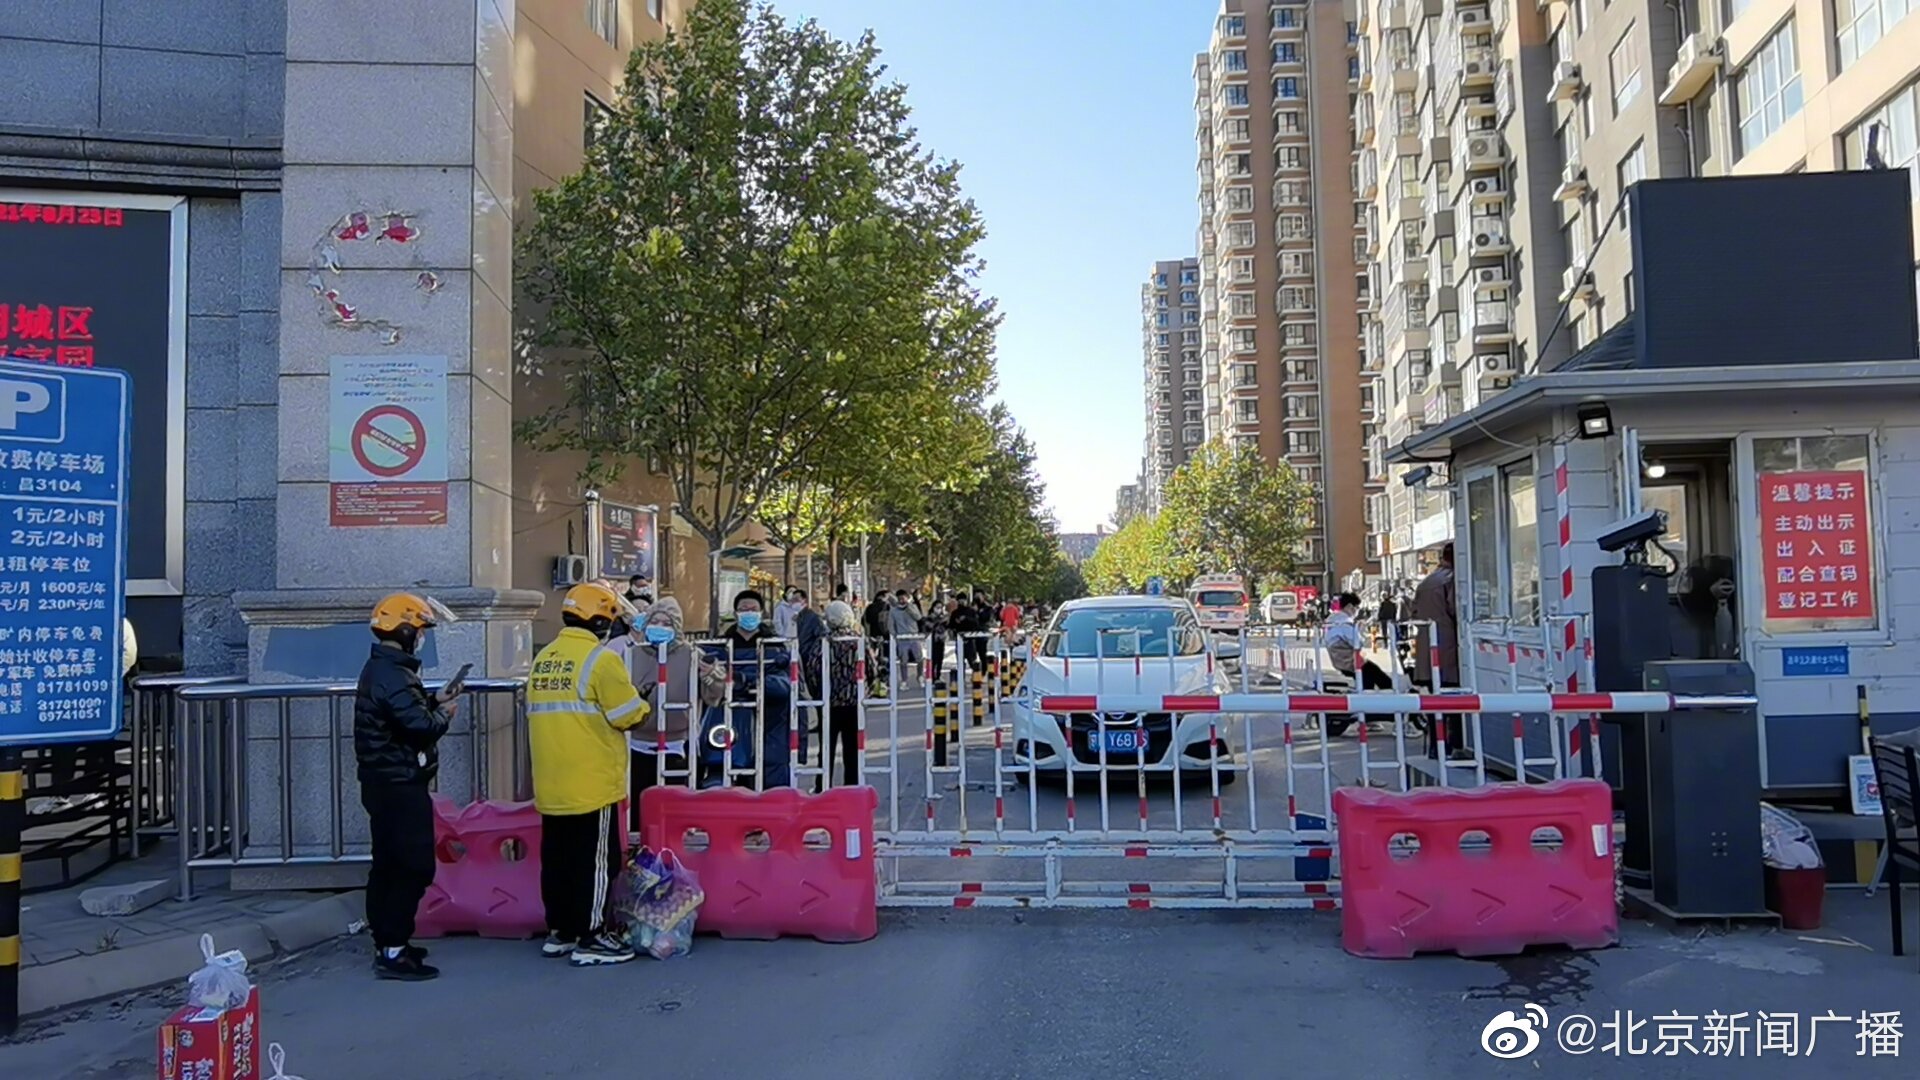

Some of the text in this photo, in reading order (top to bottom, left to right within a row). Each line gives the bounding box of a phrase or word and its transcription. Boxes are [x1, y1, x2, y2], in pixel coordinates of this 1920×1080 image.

[0, 303, 94, 340] 城区
[0, 379, 50, 430] P
[1772, 483, 1855, 502] 温馨提示
[12, 507, 105, 526] 1元/2小时
[1775, 514, 1855, 532] 主动出示
[11, 530, 105, 549] 2元/2小时
[1777, 539, 1856, 557] 出入证
[0, 556, 91, 573] 租停车位
[1777, 565, 1858, 584] 配合查码
[40, 581, 107, 595] 1600元/年
[1778, 592, 1859, 610] 登记工作
[36, 679, 108, 694] 81781099
